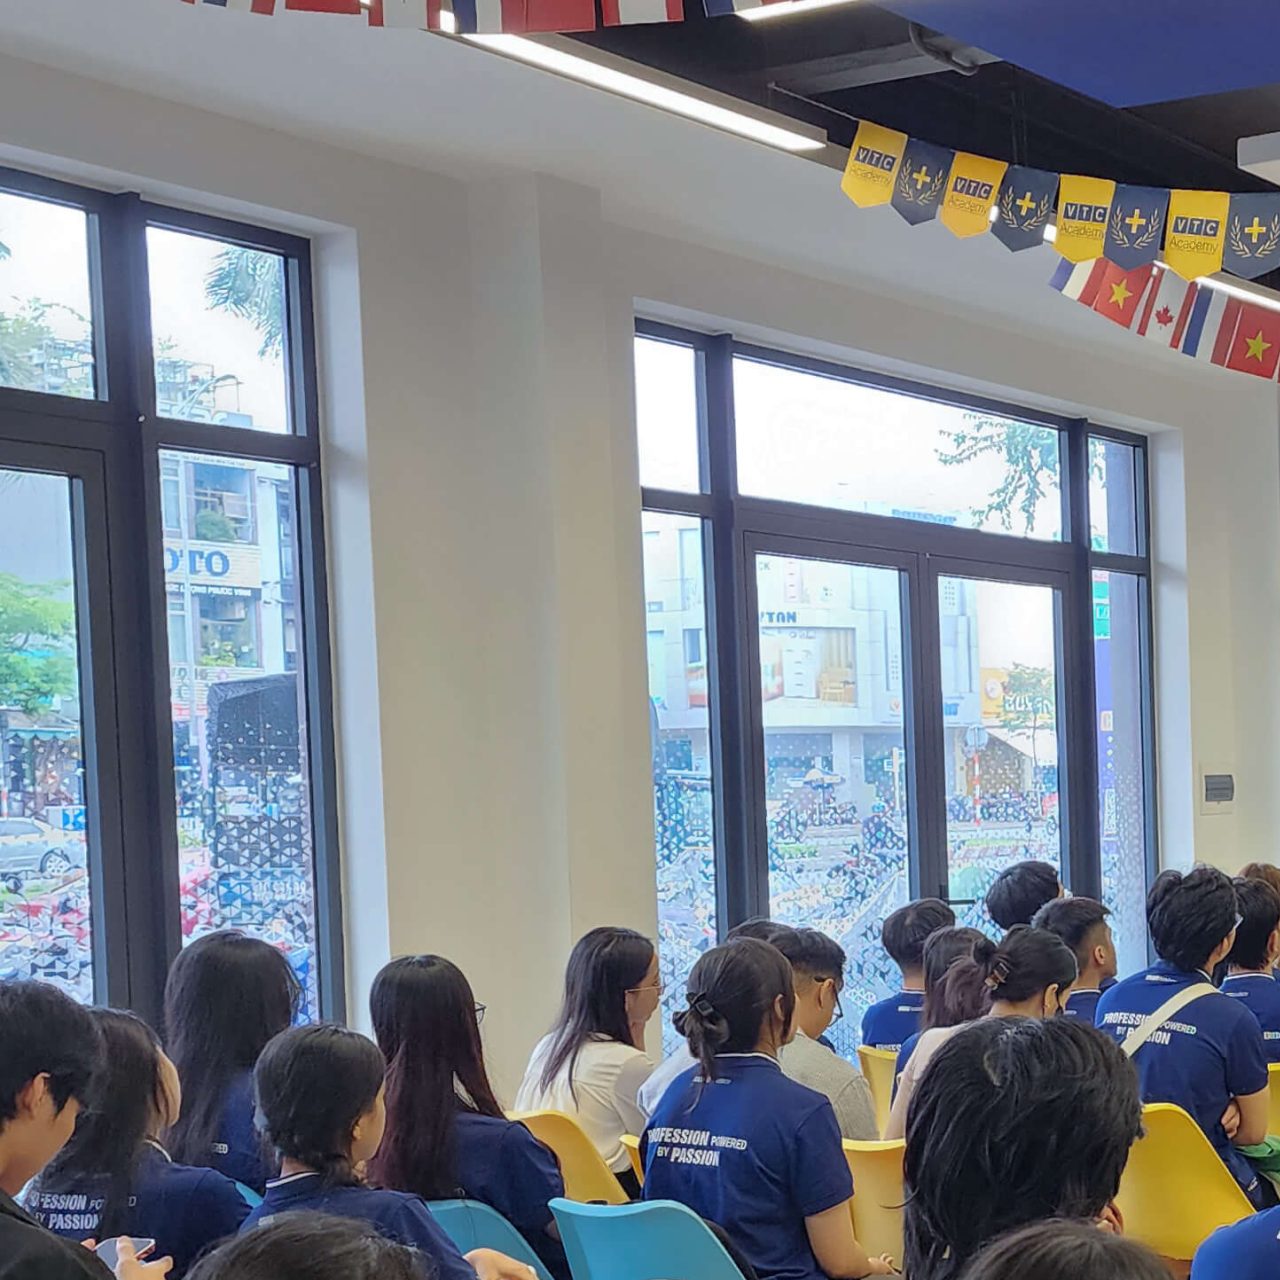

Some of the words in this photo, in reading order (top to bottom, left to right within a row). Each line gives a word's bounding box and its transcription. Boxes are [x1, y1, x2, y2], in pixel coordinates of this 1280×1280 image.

[854, 146, 895, 169] VTC
[954, 177, 993, 199] VTC
[1064, 203, 1107, 222] VTC
[1173, 217, 1219, 236] VTC
[1169, 236, 1219, 254] Academy
[711, 1134, 748, 1150] POWERED
[657, 1146, 670, 1158] BY
[670, 1147, 720, 1167] PASSION
